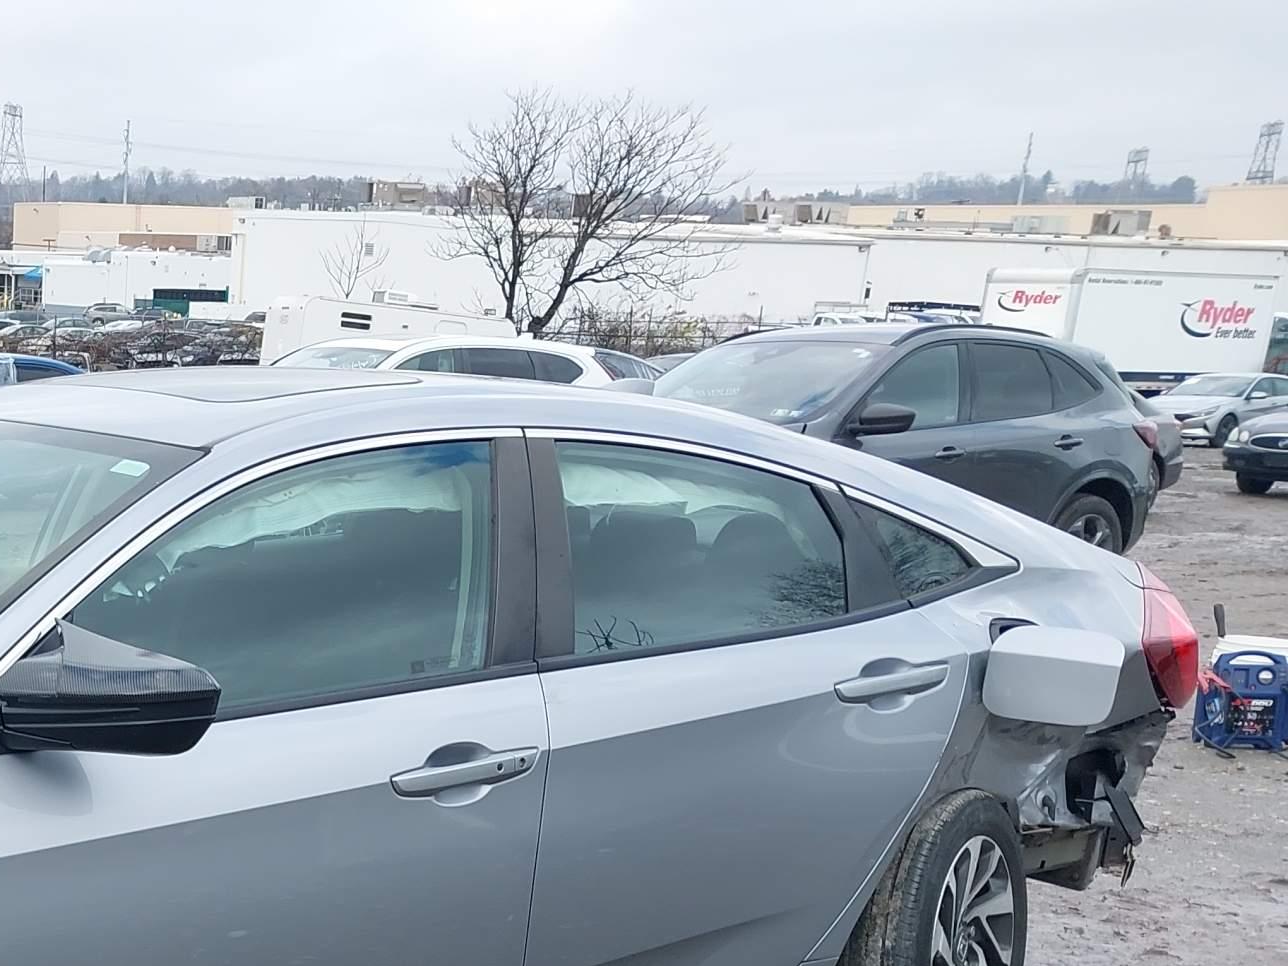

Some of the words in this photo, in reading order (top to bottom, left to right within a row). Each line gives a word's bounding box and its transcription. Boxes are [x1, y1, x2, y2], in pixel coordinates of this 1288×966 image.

[1012, 290, 1062, 307] Ryder
[1198, 299, 1255, 328] Ryder
[1214, 326, 1232, 338] Ever
